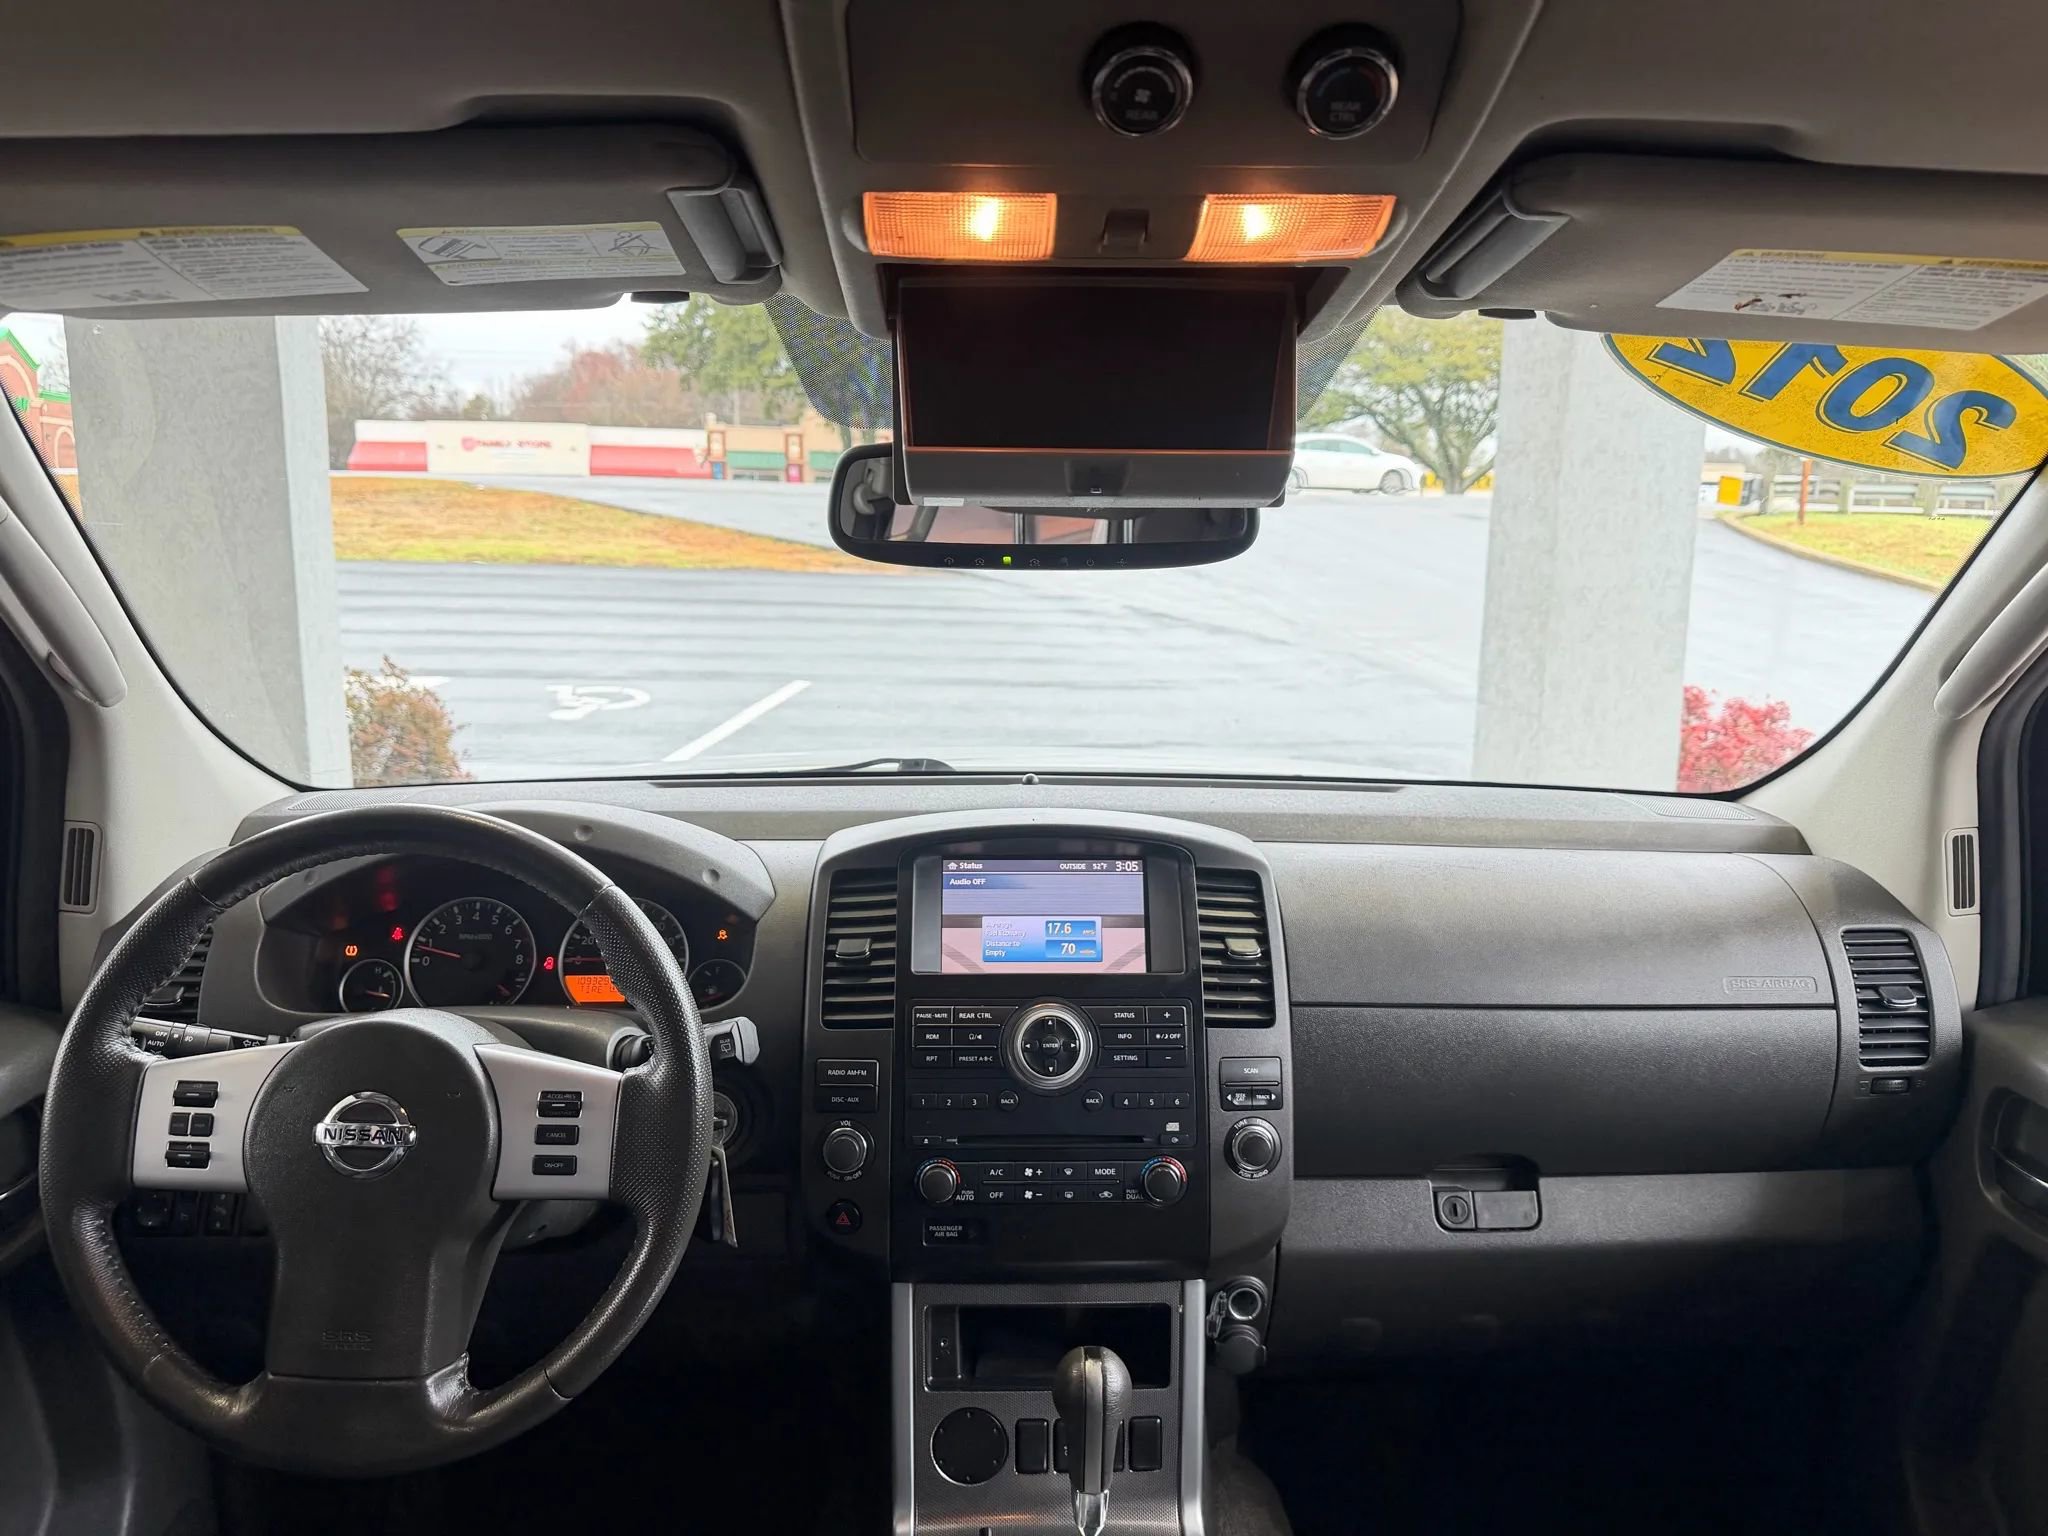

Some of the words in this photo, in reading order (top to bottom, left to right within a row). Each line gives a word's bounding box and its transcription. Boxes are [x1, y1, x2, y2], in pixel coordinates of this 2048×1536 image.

[959, 862, 983, 870] Status
[1059, 862, 1086, 870] OUTSIDE
[1115, 861, 1139, 872] 3:05
[949, 878, 971, 886] Audio
[456, 915, 462, 924] 3
[472, 911, 480, 921] 4
[491, 915, 498, 924] 5
[439, 925, 446, 934] 2
[505, 925, 512, 935] 6
[1047, 922, 1072, 935] 17.6
[514, 939, 521, 949] 7
[985, 949, 1006, 957] Empty
[1061, 943, 1076, 955] 70
[421, 955, 430, 966] 0
[515, 954, 523, 965] 8
[147, 1039, 165, 1047] AUTO
[946, 1098, 952, 1106] 2
[971, 1098, 977, 1106] 3
[1123, 1098, 1129, 1106] 4
[1149, 1098, 1155, 1106] 5
[1174, 1098, 1180, 1106] 6
[324, 1127, 403, 1142] NISSAN
[989, 1167, 1004, 1176] A/C
[1094, 1167, 1116, 1176] MODE
[989, 1191, 1004, 1199] OFF
